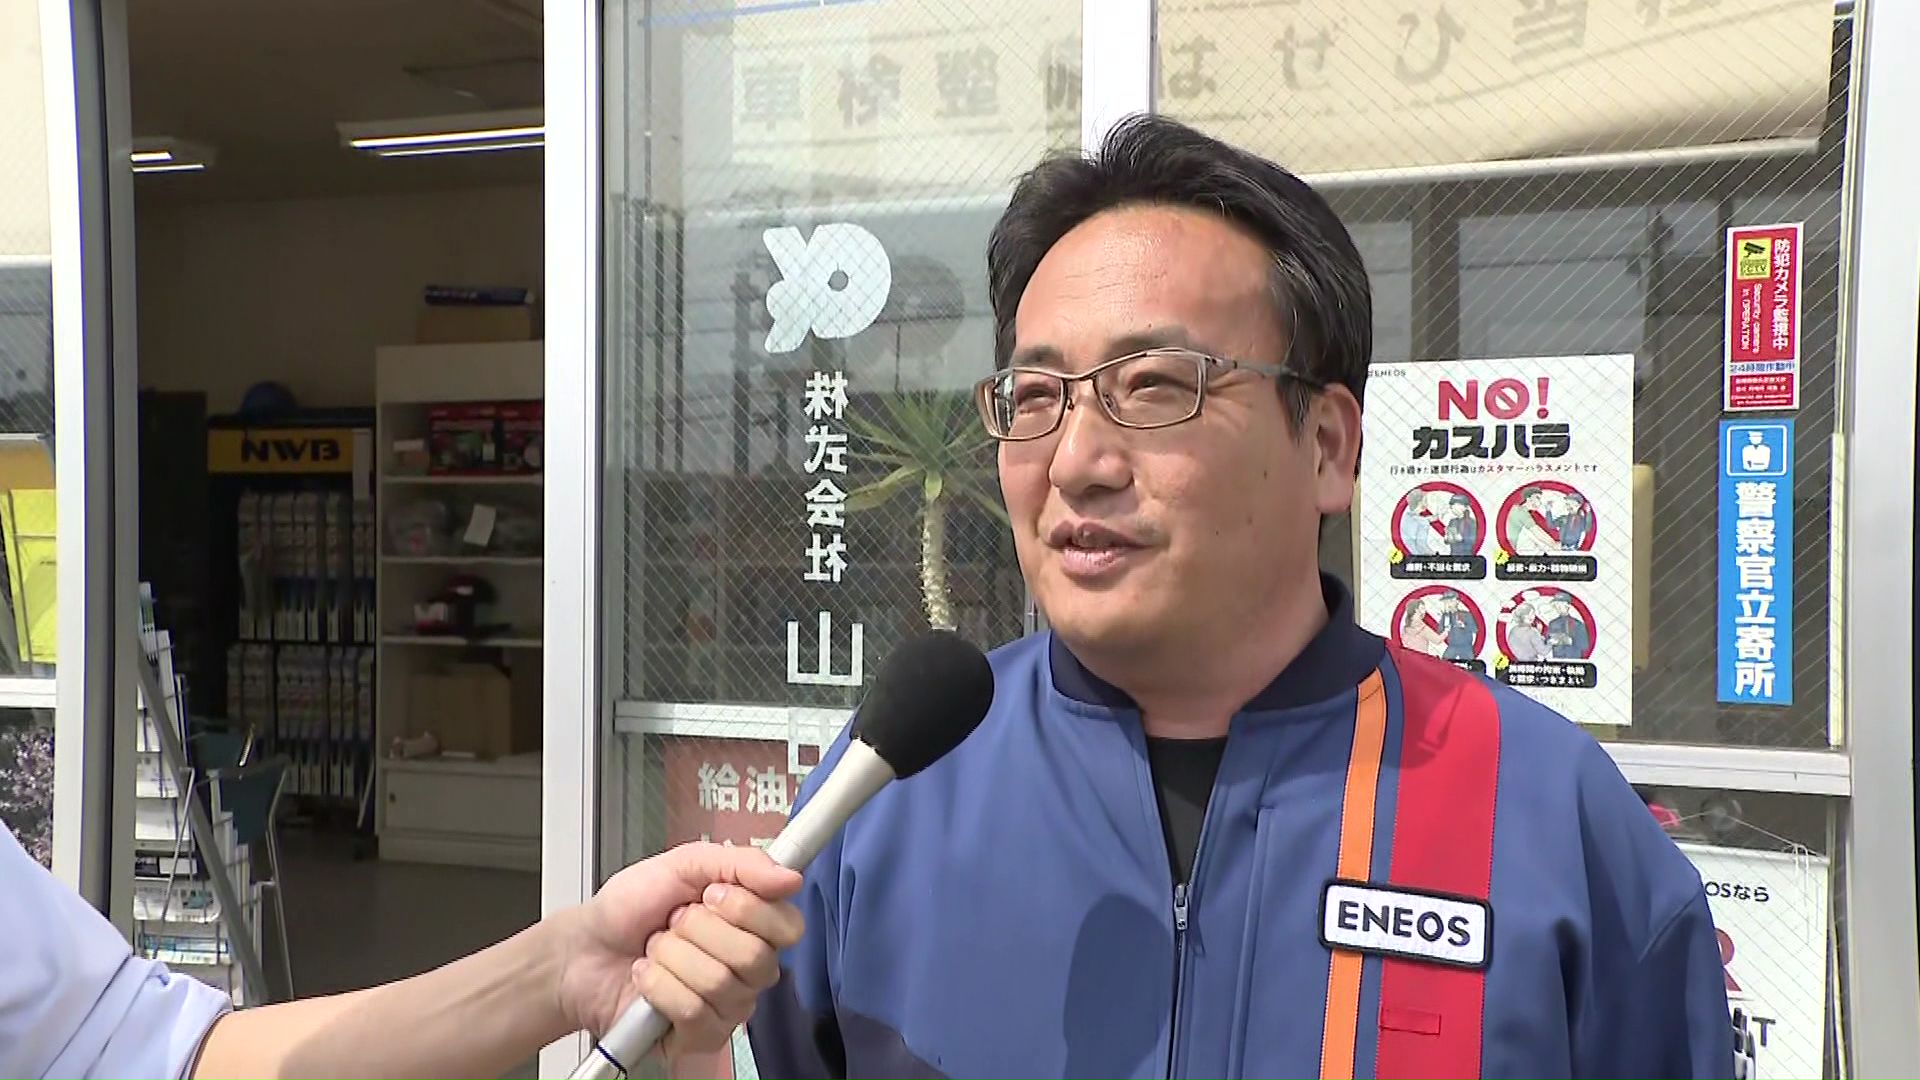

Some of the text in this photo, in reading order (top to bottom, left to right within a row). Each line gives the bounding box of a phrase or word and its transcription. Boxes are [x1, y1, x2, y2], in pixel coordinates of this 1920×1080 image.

[1438, 377, 1550, 421] NO!
[240, 438, 341, 464] NWB
[1411, 423, 1571, 460] カスハラ
[1735, 481, 1777, 700] 警察官立寄所
[697, 761, 804, 816] 給油
[1337, 900, 1471, 947] ENEOS
